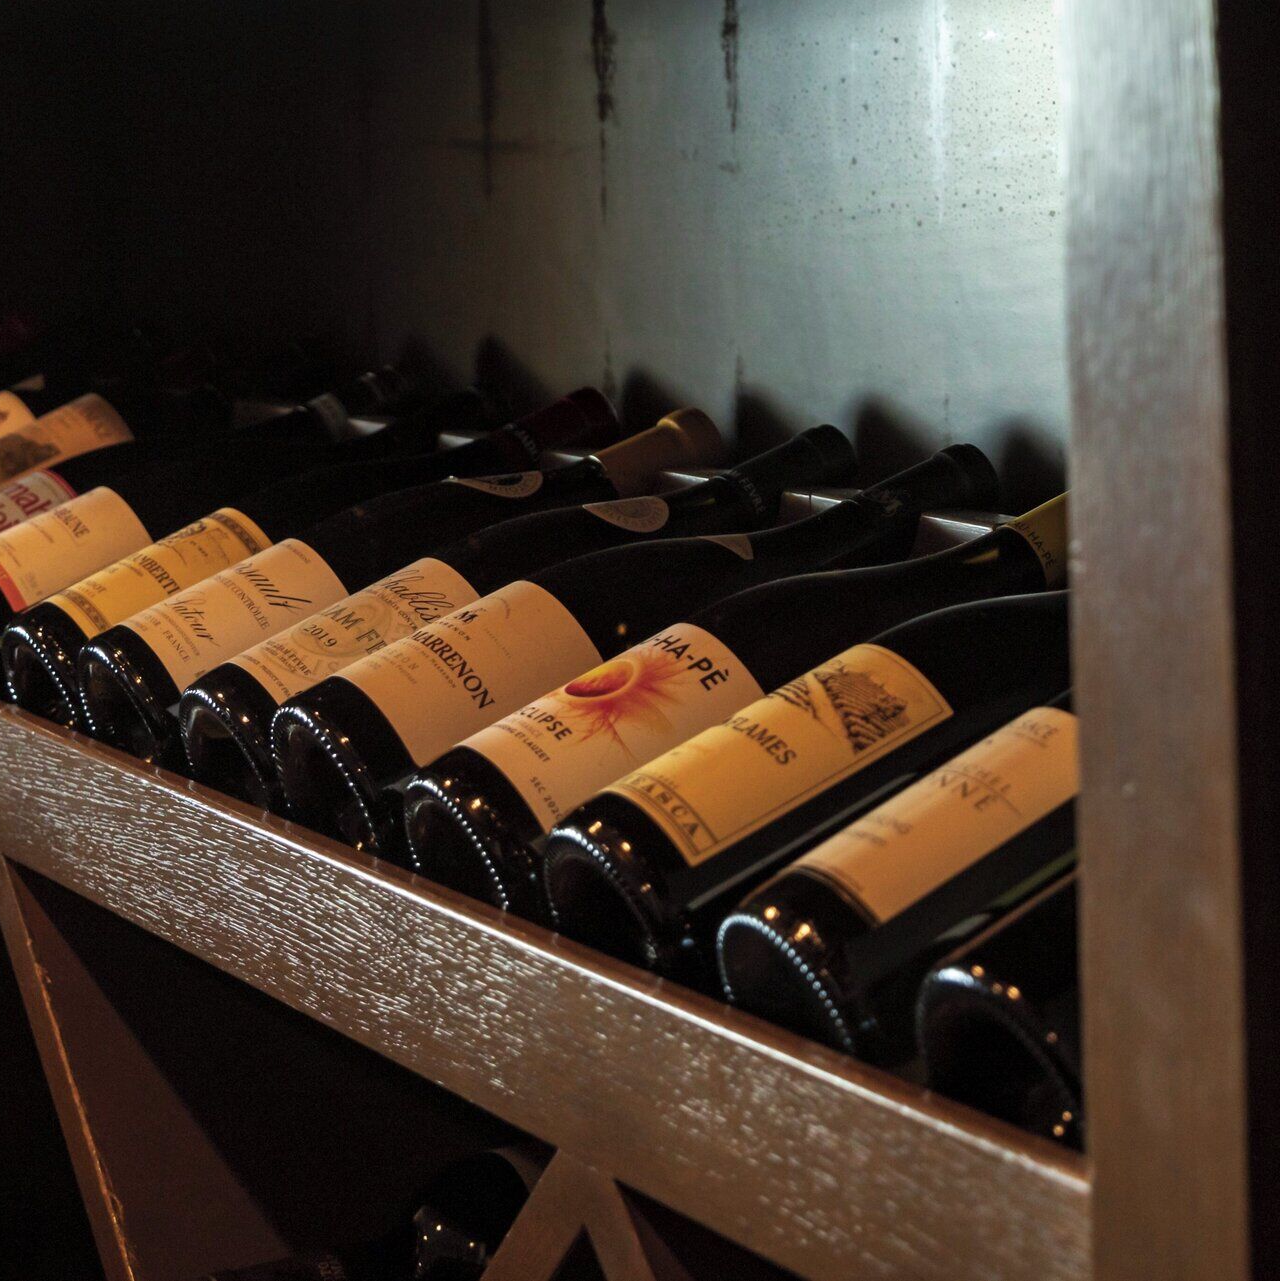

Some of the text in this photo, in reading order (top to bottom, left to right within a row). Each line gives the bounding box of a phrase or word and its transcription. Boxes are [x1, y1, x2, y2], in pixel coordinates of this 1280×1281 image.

[163, 630, 190, 663] FRANCE
[303, 623, 338, 650] 2019
[640, 634, 730, 691] -HA-PÈ
[519, 706, 573, 741] CLIPSE
[530, 775, 546, 795] SEC
